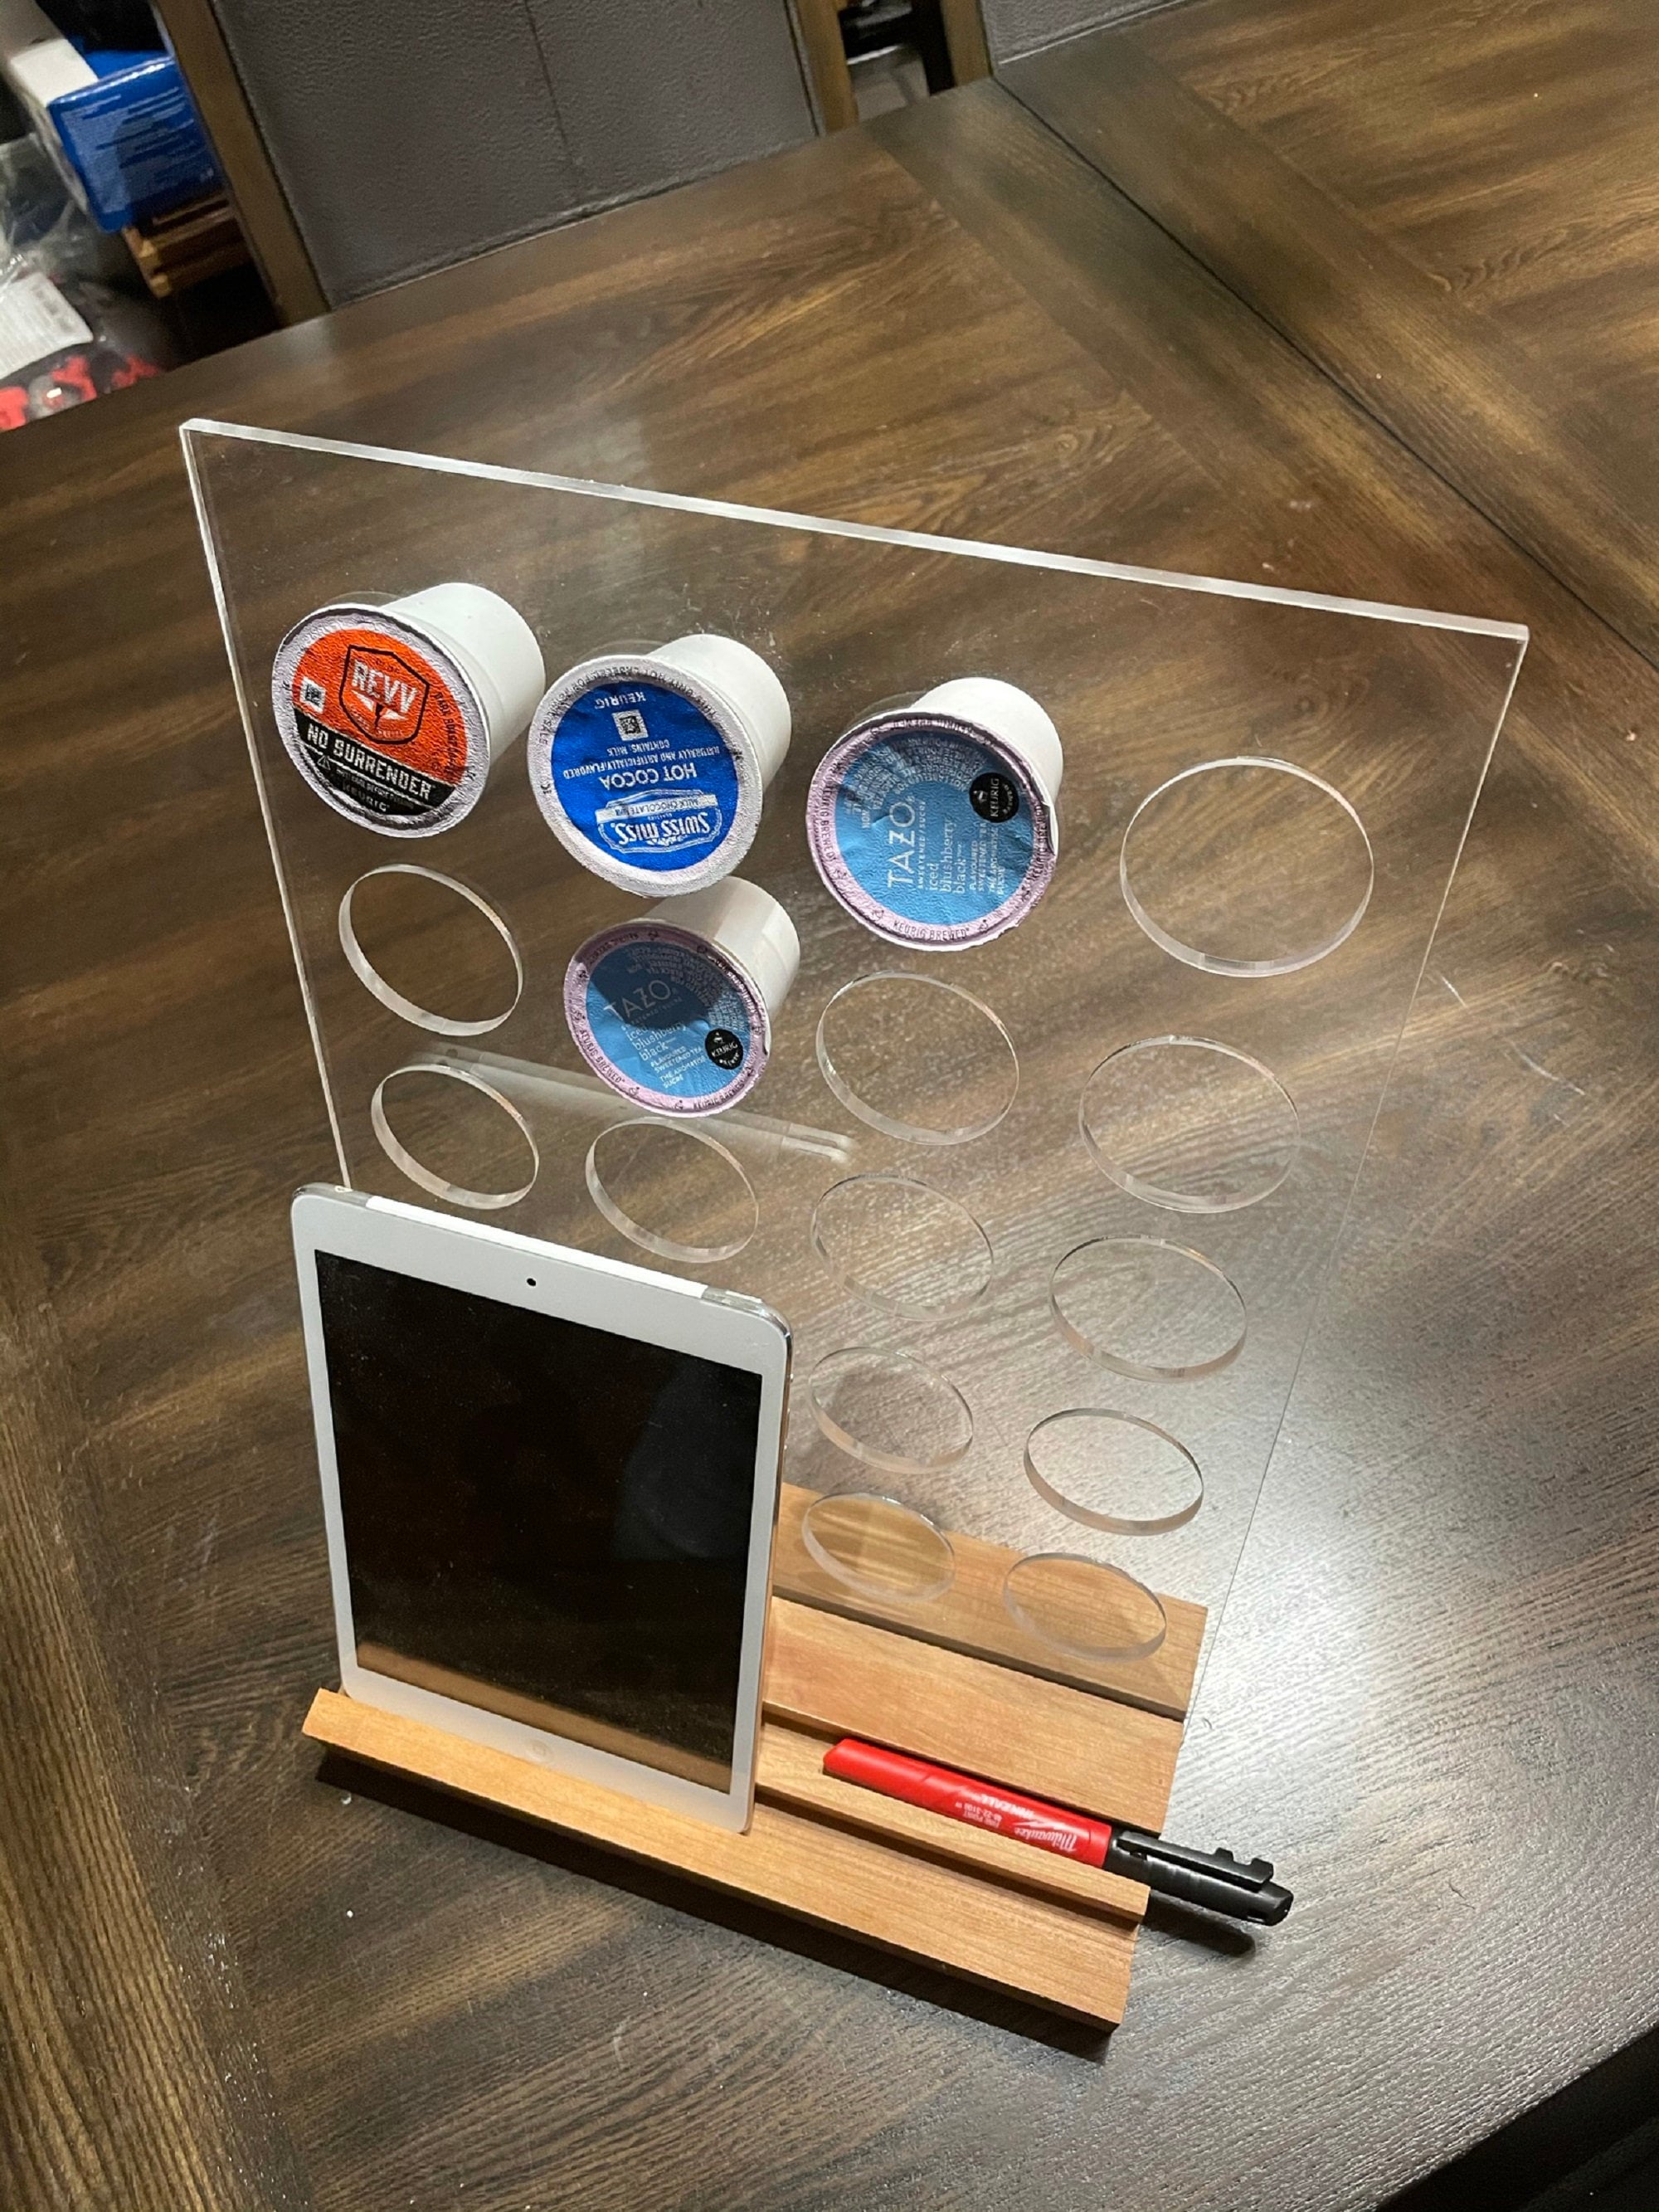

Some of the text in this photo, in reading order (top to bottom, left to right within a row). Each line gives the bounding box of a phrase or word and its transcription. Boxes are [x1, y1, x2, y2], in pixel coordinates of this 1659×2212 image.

[352, 659, 419, 714] REVV
[596, 692, 646, 709] KEURIG
[307, 724, 432, 799] NO SURRENDER
[675, 746, 720, 760] NATURALLY
[563, 763, 607, 779] FLAVORED
[600, 763, 697, 790] HOT COCOA
[630, 801, 682, 816] CHOCOLATE
[990, 777, 999, 816] KEURIG
[617, 811, 710, 845] SWISS MISS
[885, 801, 915, 889] TAZO
[939, 820, 956, 892] blushberry
[925, 862, 939, 890] iced
[952, 858, 966, 894] black
[893, 918, 927, 939] KEURIG
[604, 980, 672, 1021] TAZO
[625, 1022, 649, 1041] iced
[631, 1021, 688, 1050] blushberry
[637, 1040, 669, 1061] black
[710, 1040, 738, 1058] KEURIG
[1012, 1826, 1076, 1852] Milwaukee
